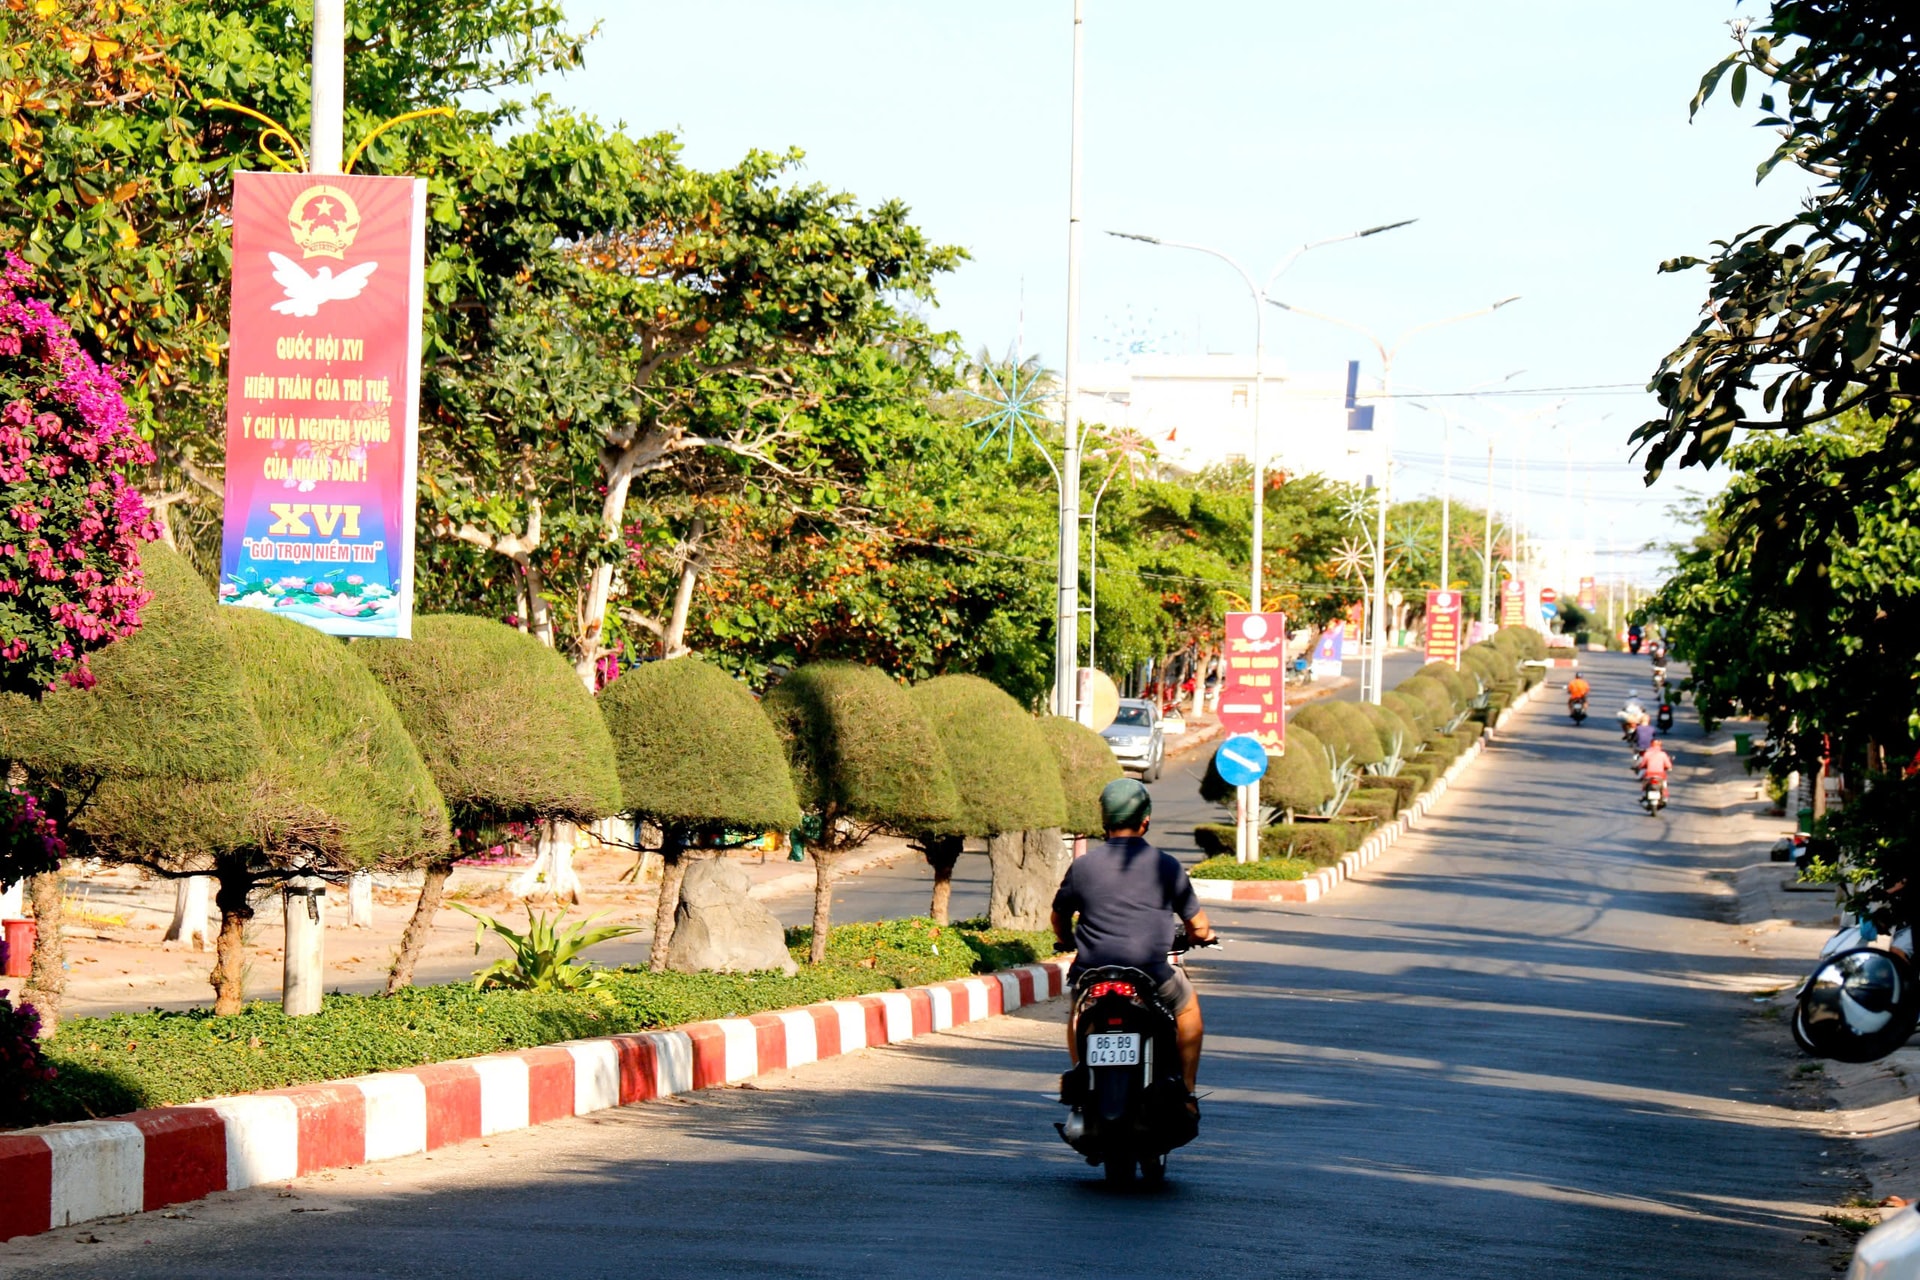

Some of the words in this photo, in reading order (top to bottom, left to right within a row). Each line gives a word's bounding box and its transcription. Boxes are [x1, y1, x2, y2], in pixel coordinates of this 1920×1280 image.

[276, 329, 312, 361] QUỐC
[315, 333, 339, 366] HỘI
[341, 338, 364, 361] XVI
[244, 372, 275, 404] HIỆN
[278, 373, 312, 400] THÂN
[315, 372, 340, 401] CỦA
[343, 374, 363, 402] TRÍ
[365, 375, 392, 408] TUỆ,
[242, 411, 252, 439] Ý
[254, 411, 276, 439] CHÍ
[278, 412, 296, 440] VÀ
[298, 414, 351, 446] NGUYỆN
[353, 419, 391, 447] VỌNG
[263, 451, 289, 480] CỦA
[291, 456, 329, 481] NHÂN
[331, 455, 359, 482] DÂN
[268, 503, 361, 537] XVI
[276, 542, 312, 563] TRỌN
[1090, 1049, 1136, 1063] 043.09
[1096, 1035, 1132, 1049] 86-B9
